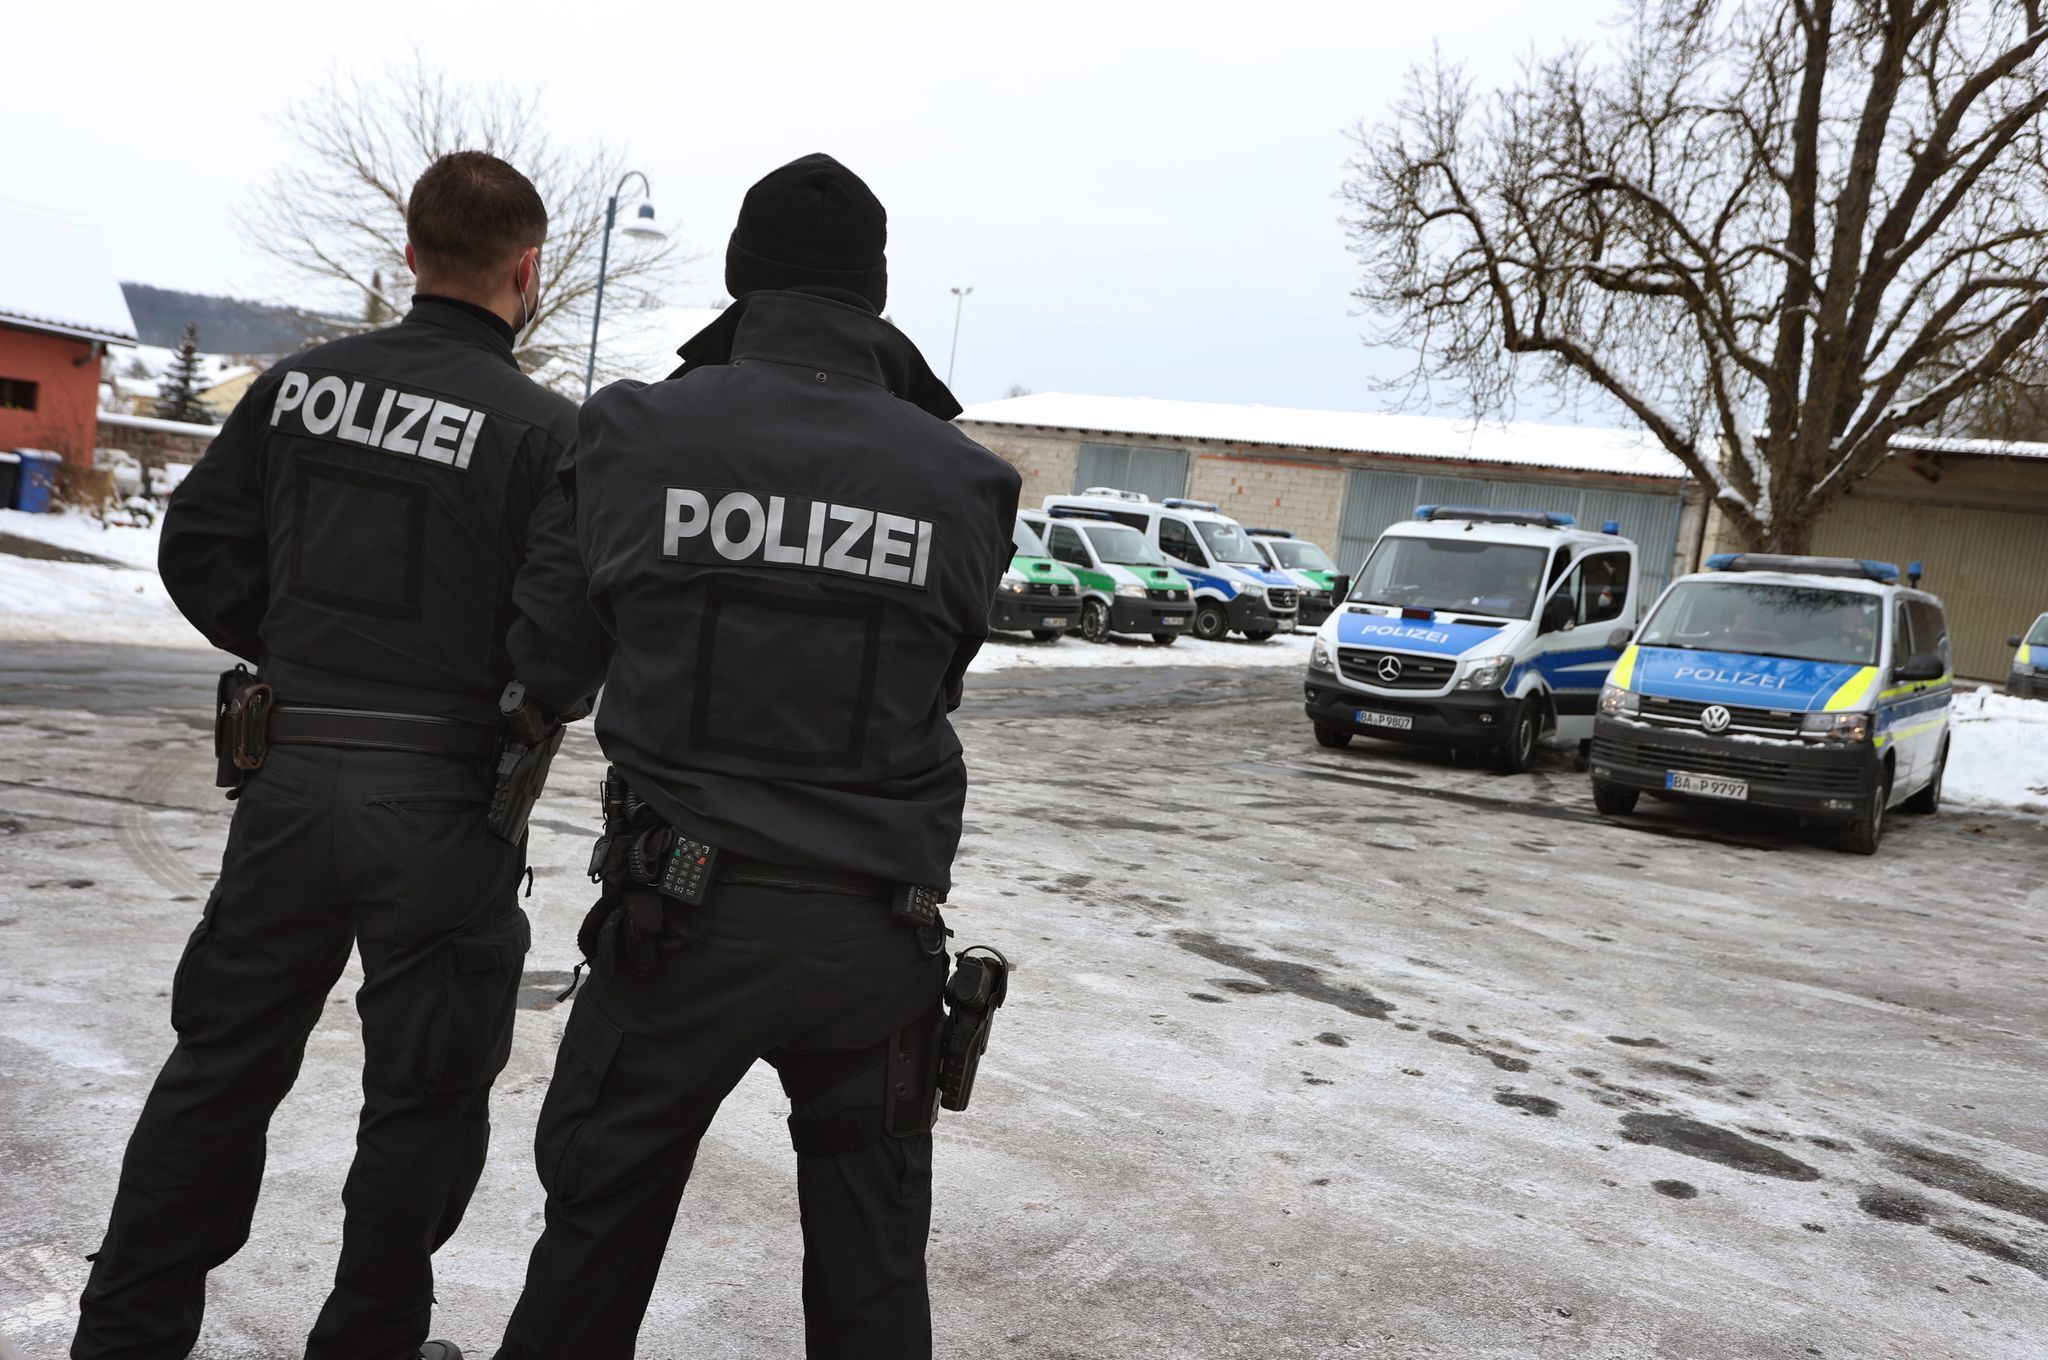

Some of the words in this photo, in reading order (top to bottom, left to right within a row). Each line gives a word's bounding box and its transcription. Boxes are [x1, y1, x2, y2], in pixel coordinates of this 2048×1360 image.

[270, 371, 486, 469] POLIZEI
[663, 488, 933, 586] POLIZEI
[1361, 625, 1449, 644] POLIZEI
[1674, 667, 1786, 690] POLIZEI
[1361, 712, 1373, 723] BA
[1387, 716, 1410, 727] 9807
[1674, 776, 1691, 789] BA
[1701, 780, 1709, 791] P
[1711, 782, 1745, 796] 9797
